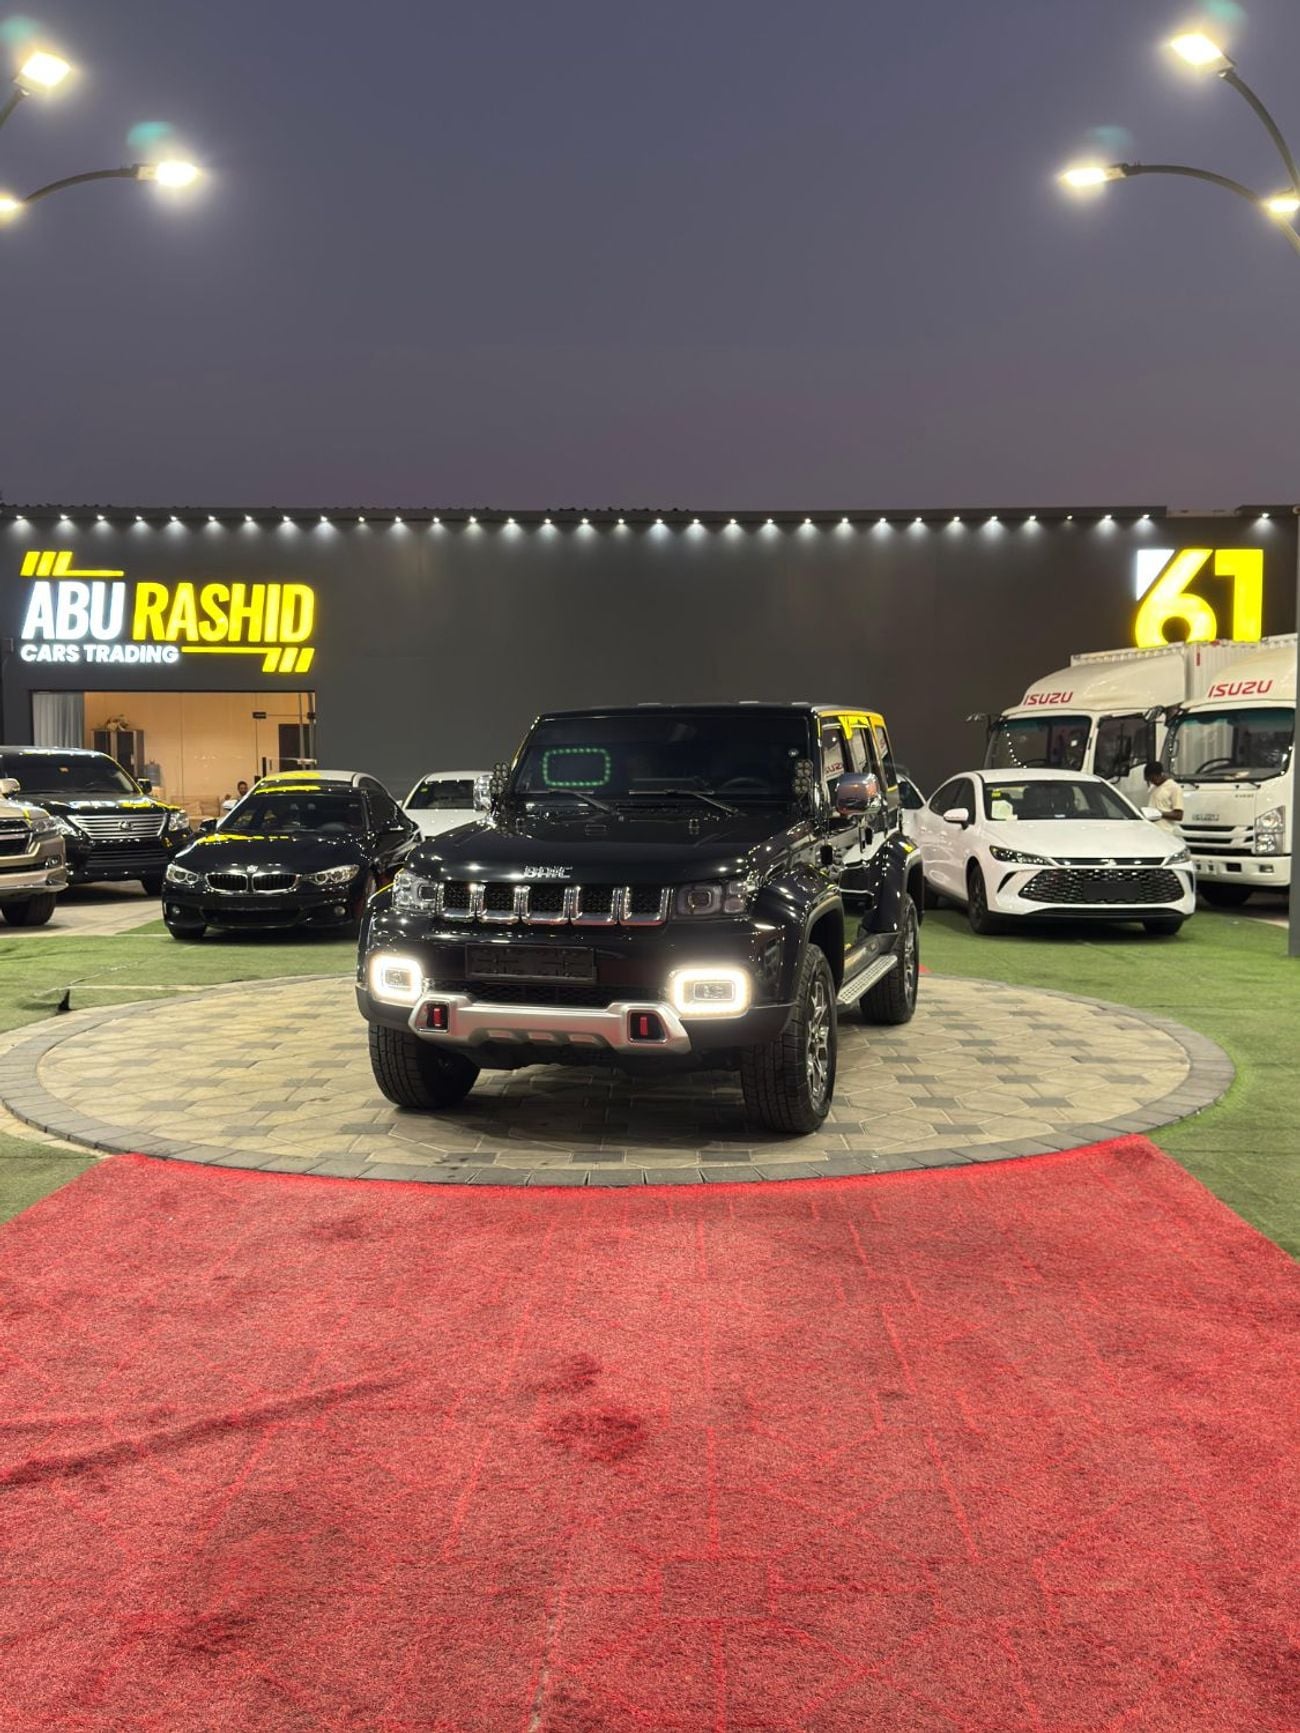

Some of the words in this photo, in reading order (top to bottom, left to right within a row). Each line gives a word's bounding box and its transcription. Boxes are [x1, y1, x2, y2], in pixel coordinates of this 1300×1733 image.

[1135, 549, 1263, 649] 61
[21, 581, 126, 640] ABU
[132, 582, 315, 642] RASHID
[20, 644, 80, 663] CARS
[83, 645, 179, 663] TRADING
[1023, 691, 1073, 706] ISUZU
[1208, 680, 1272, 698] ISUZU
